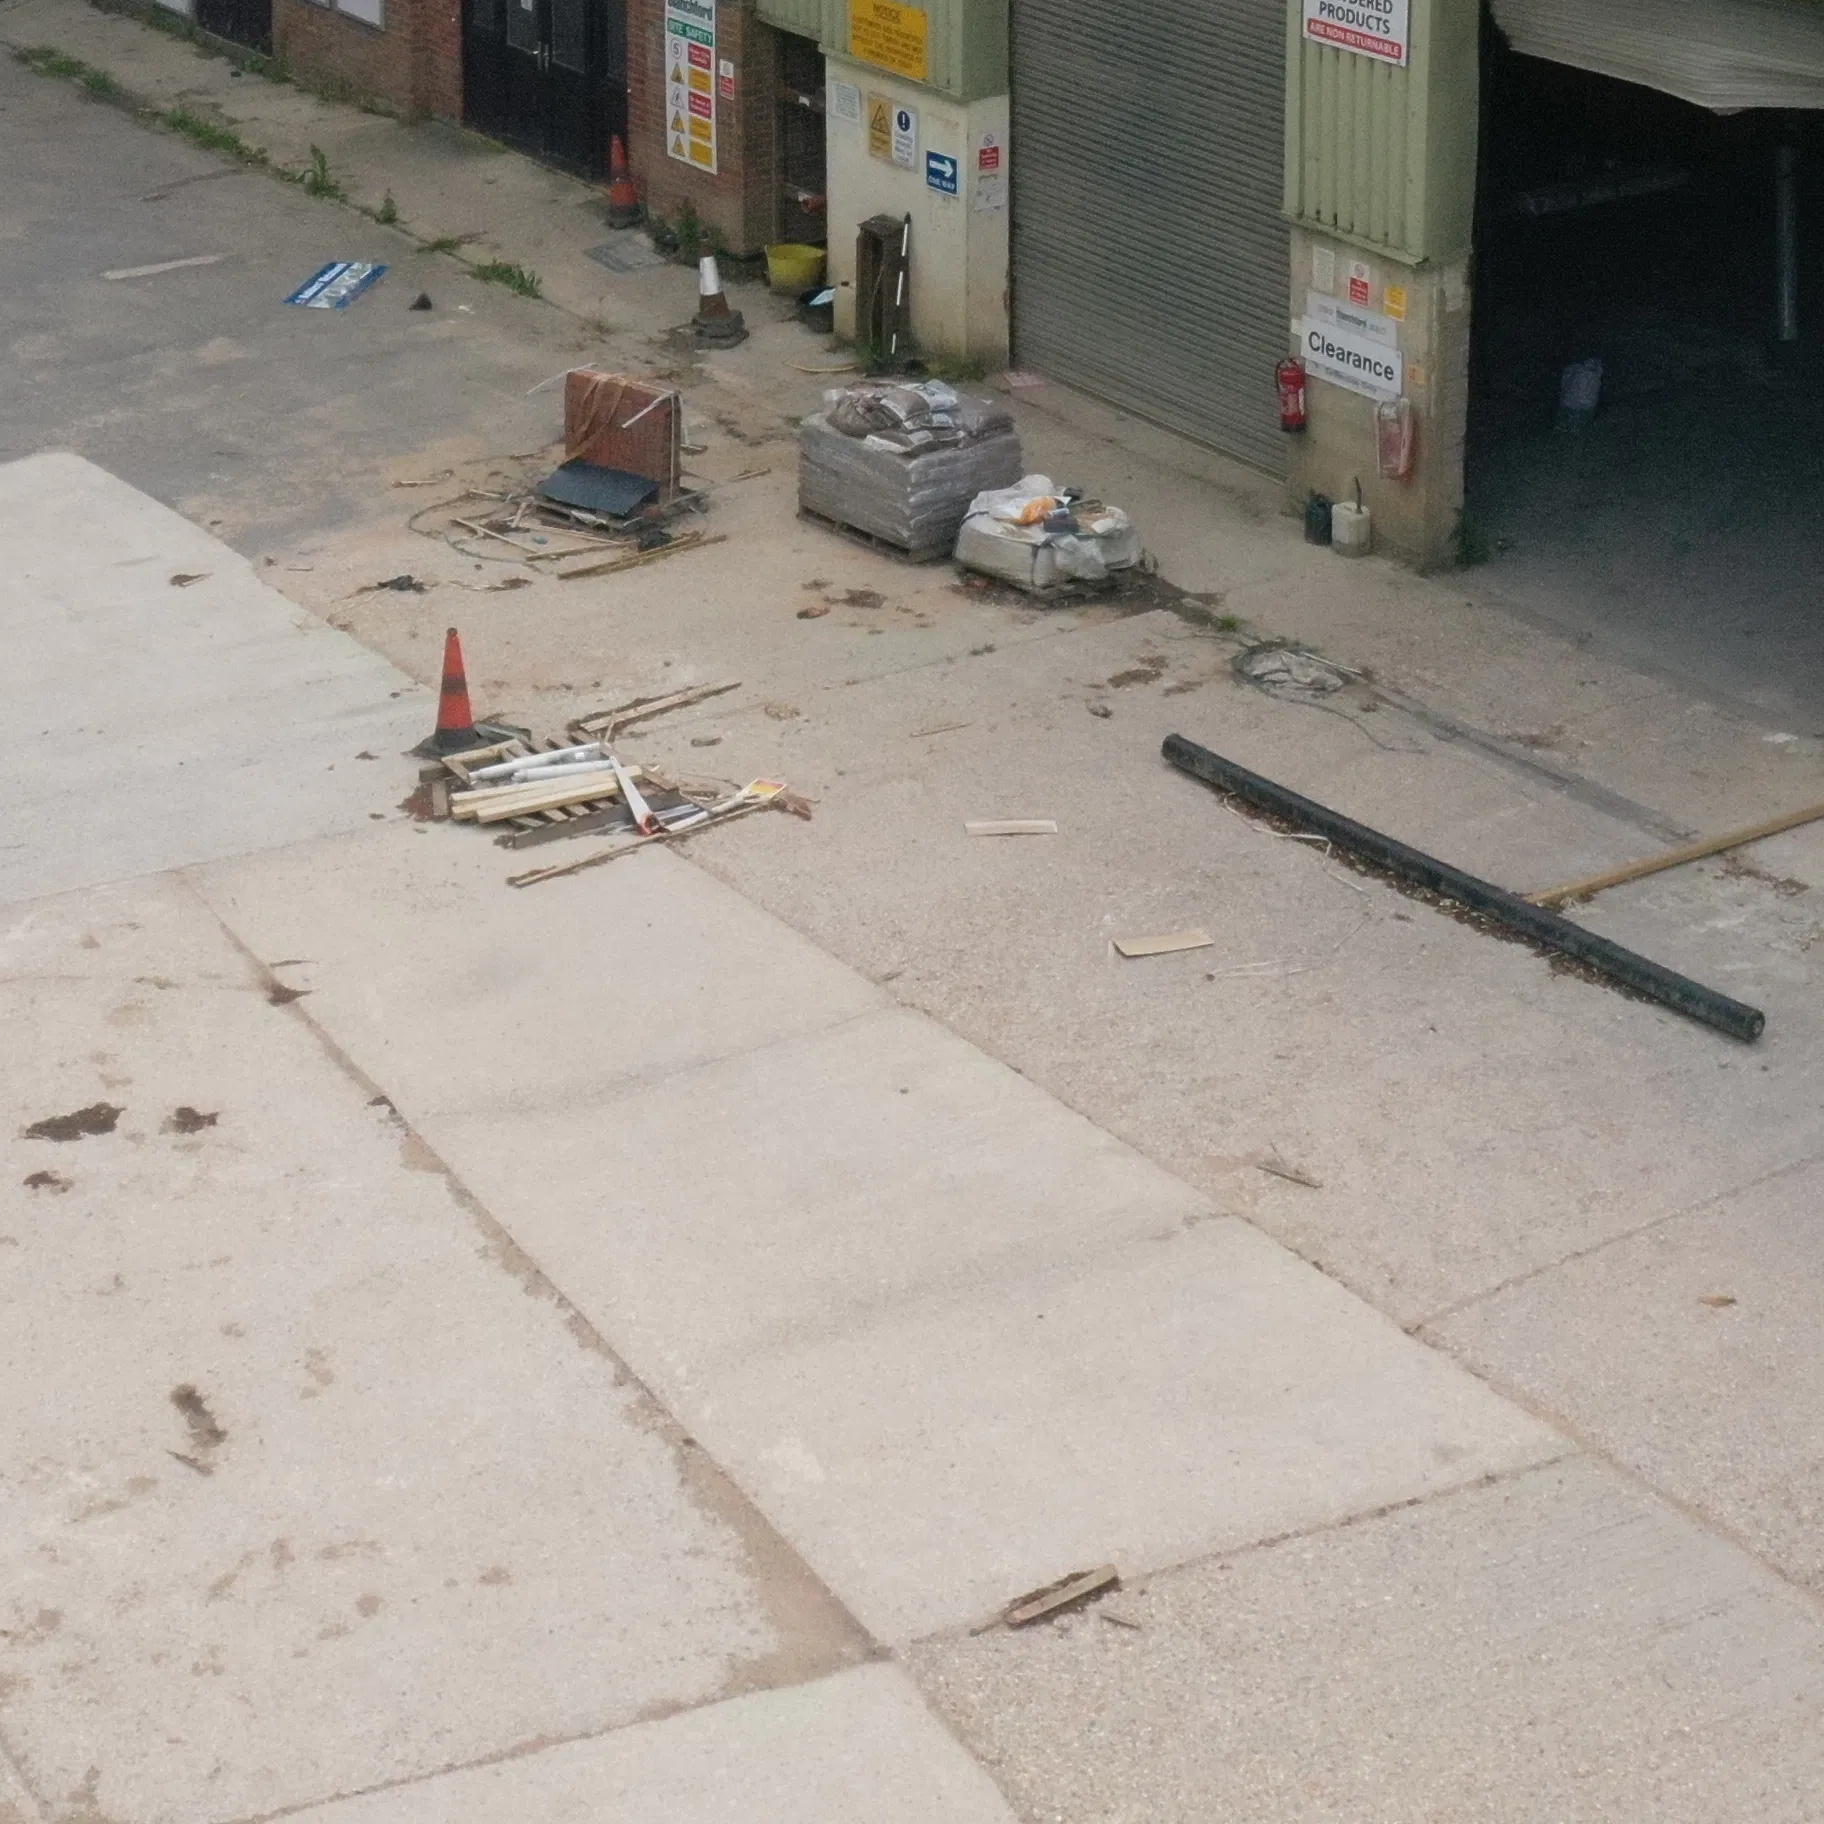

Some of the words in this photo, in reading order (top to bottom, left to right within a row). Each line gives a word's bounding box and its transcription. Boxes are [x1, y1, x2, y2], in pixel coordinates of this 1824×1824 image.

[669, 20, 684, 35] SITE
[685, 24, 713, 44] SAFETY
[1319, 1, 1390, 35] PRODUCTS
[1310, 22, 1325, 35] ARE
[1326, 27, 1345, 40] NON
[1346, 32, 1399, 57] RETURNABLE
[1308, 331, 1395, 381] Clearance
